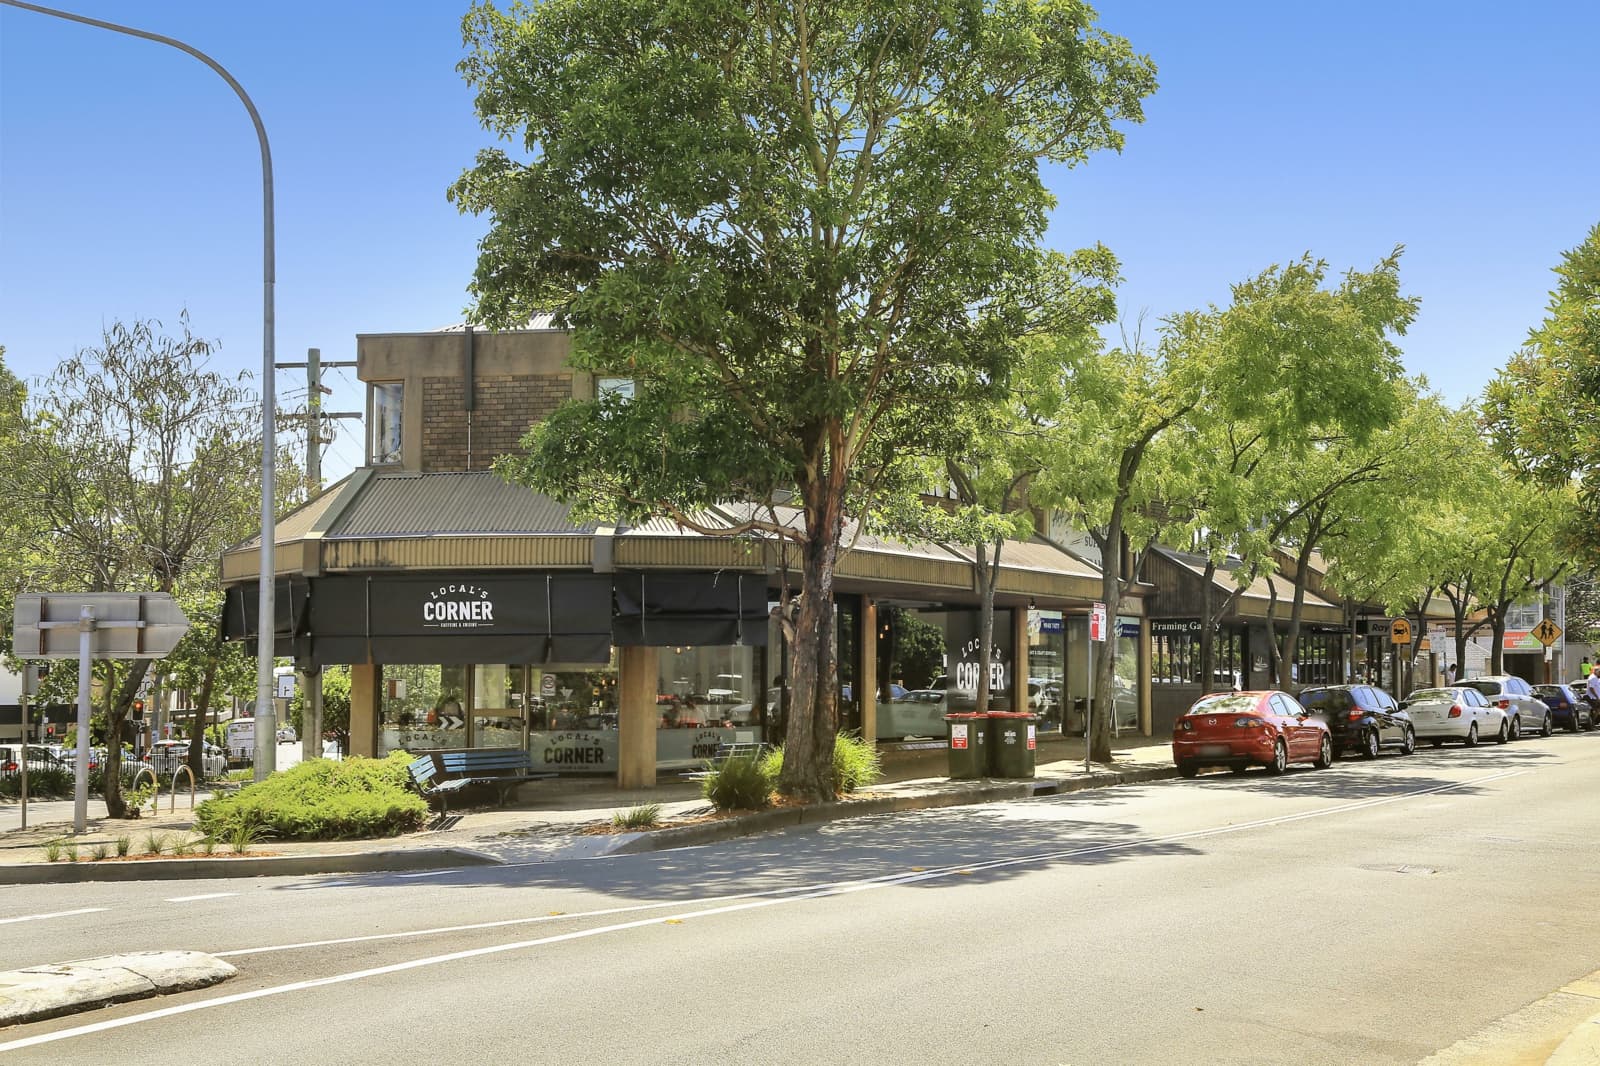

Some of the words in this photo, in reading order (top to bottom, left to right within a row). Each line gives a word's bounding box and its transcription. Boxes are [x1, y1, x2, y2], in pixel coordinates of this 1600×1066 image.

[430, 584, 489, 599] LOCAL'S
[423, 601, 494, 621] CORNER
[1152, 621, 1188, 632] Framing
[961, 638, 1002, 660] LOC'S
[956, 662, 1005, 690] CORER
[551, 732, 600, 746] LOCAL'S
[543, 747, 604, 765] CORNER
